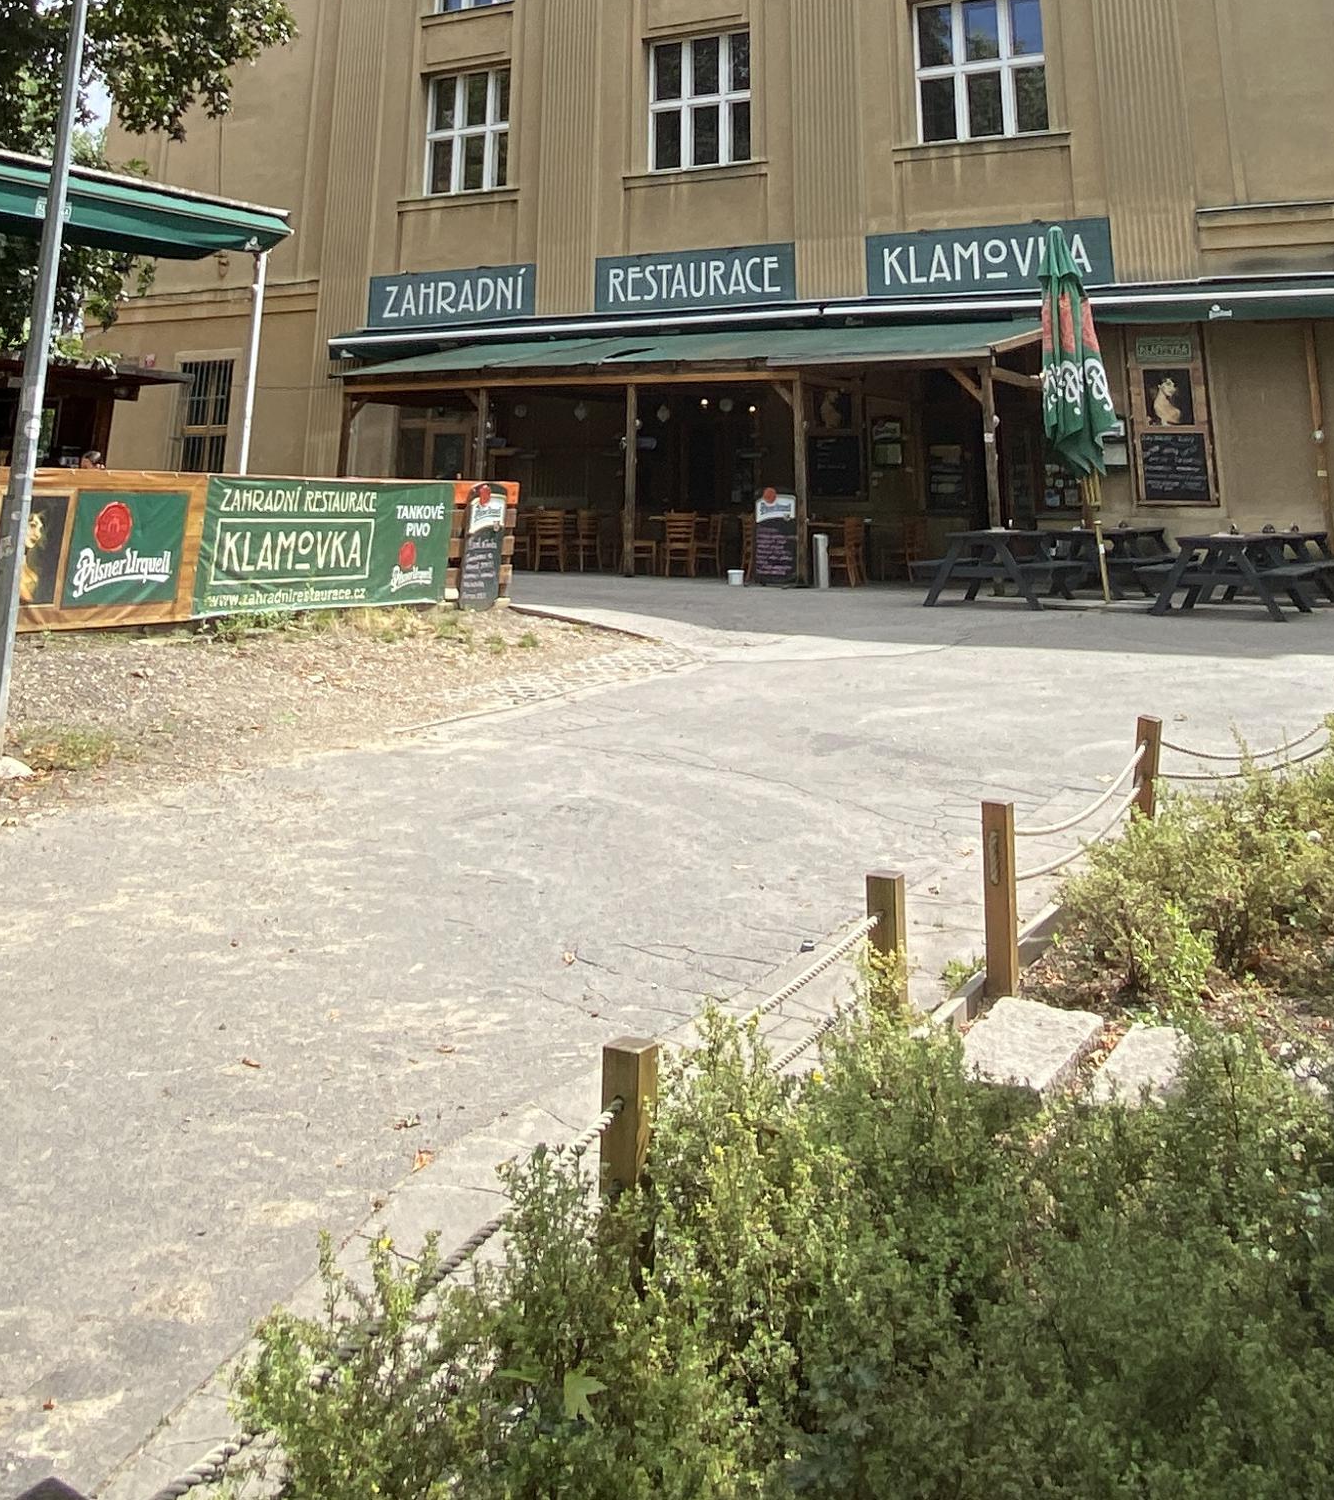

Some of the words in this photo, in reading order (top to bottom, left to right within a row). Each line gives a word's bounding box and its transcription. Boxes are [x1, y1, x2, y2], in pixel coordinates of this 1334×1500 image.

[383, 268, 525, 318] ZAHRADNÍ
[609, 257, 781, 303] RESTAURACE
[220, 486, 302, 513] ZAHRADNÍ
[303, 491, 377, 513] RESTAURACE
[396, 503, 445, 520] TANKOVÉ
[406, 522, 431, 537] PIVO
[222, 530, 361, 573] KLAMOVKA
[72, 547, 126, 598] Pilsner
[124, 547, 171, 583] Urquell
[206, 587, 367, 608] www.zahradnirestaurace.cz
